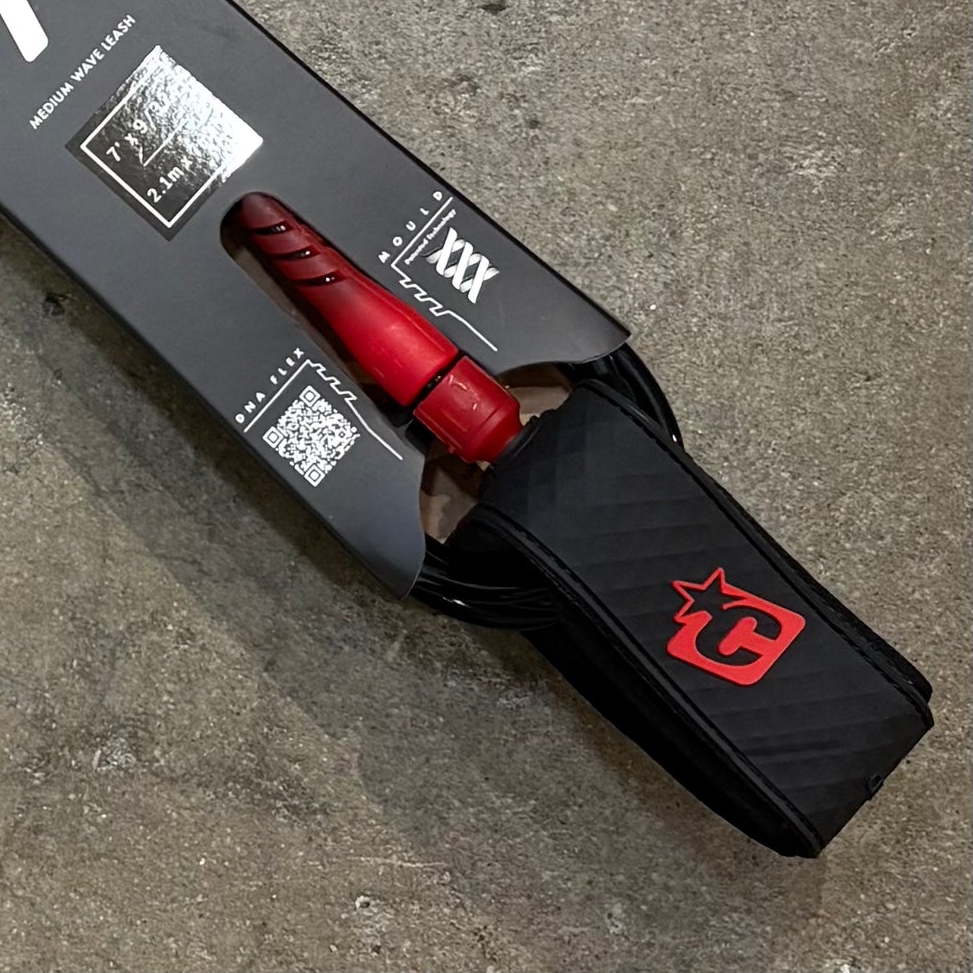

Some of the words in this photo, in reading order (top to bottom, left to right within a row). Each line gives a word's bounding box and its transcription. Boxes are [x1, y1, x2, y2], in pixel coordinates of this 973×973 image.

[29, 82, 75, 130] MEDIUM
[70, 48, 105, 82] WAVE
[100, 14, 136, 51] LEASH
[146, 165, 185, 203] 2.1m
[378, 191, 443, 264] MOULD
[234, 392, 266, 424] DNA
[269, 347, 305, 385] FLEX
